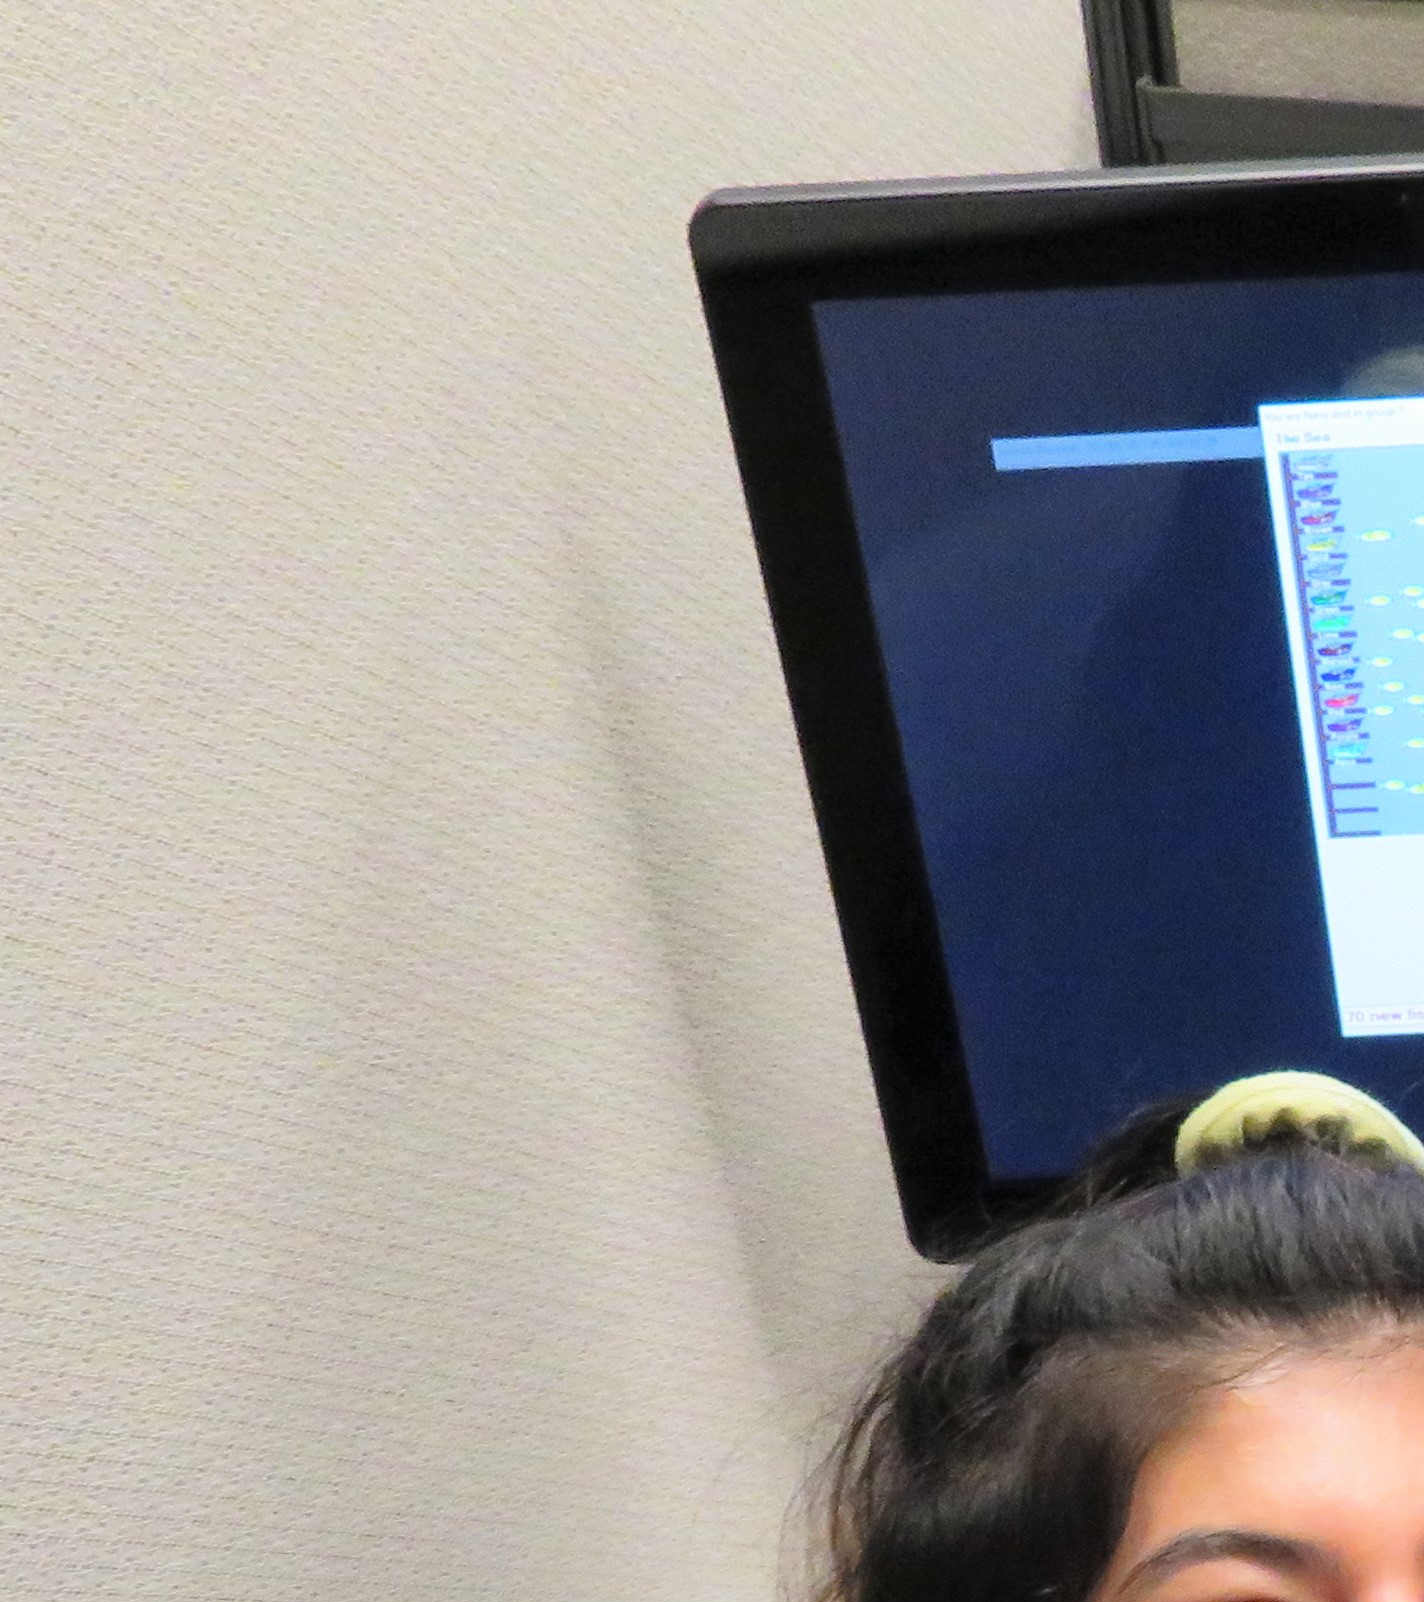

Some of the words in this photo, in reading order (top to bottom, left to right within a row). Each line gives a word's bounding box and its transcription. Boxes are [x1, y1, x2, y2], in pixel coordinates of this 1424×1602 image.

[1276, 432, 1300, 444] The
[1303, 431, 1331, 443] Sea
[1369, 1010, 1403, 1021] new
